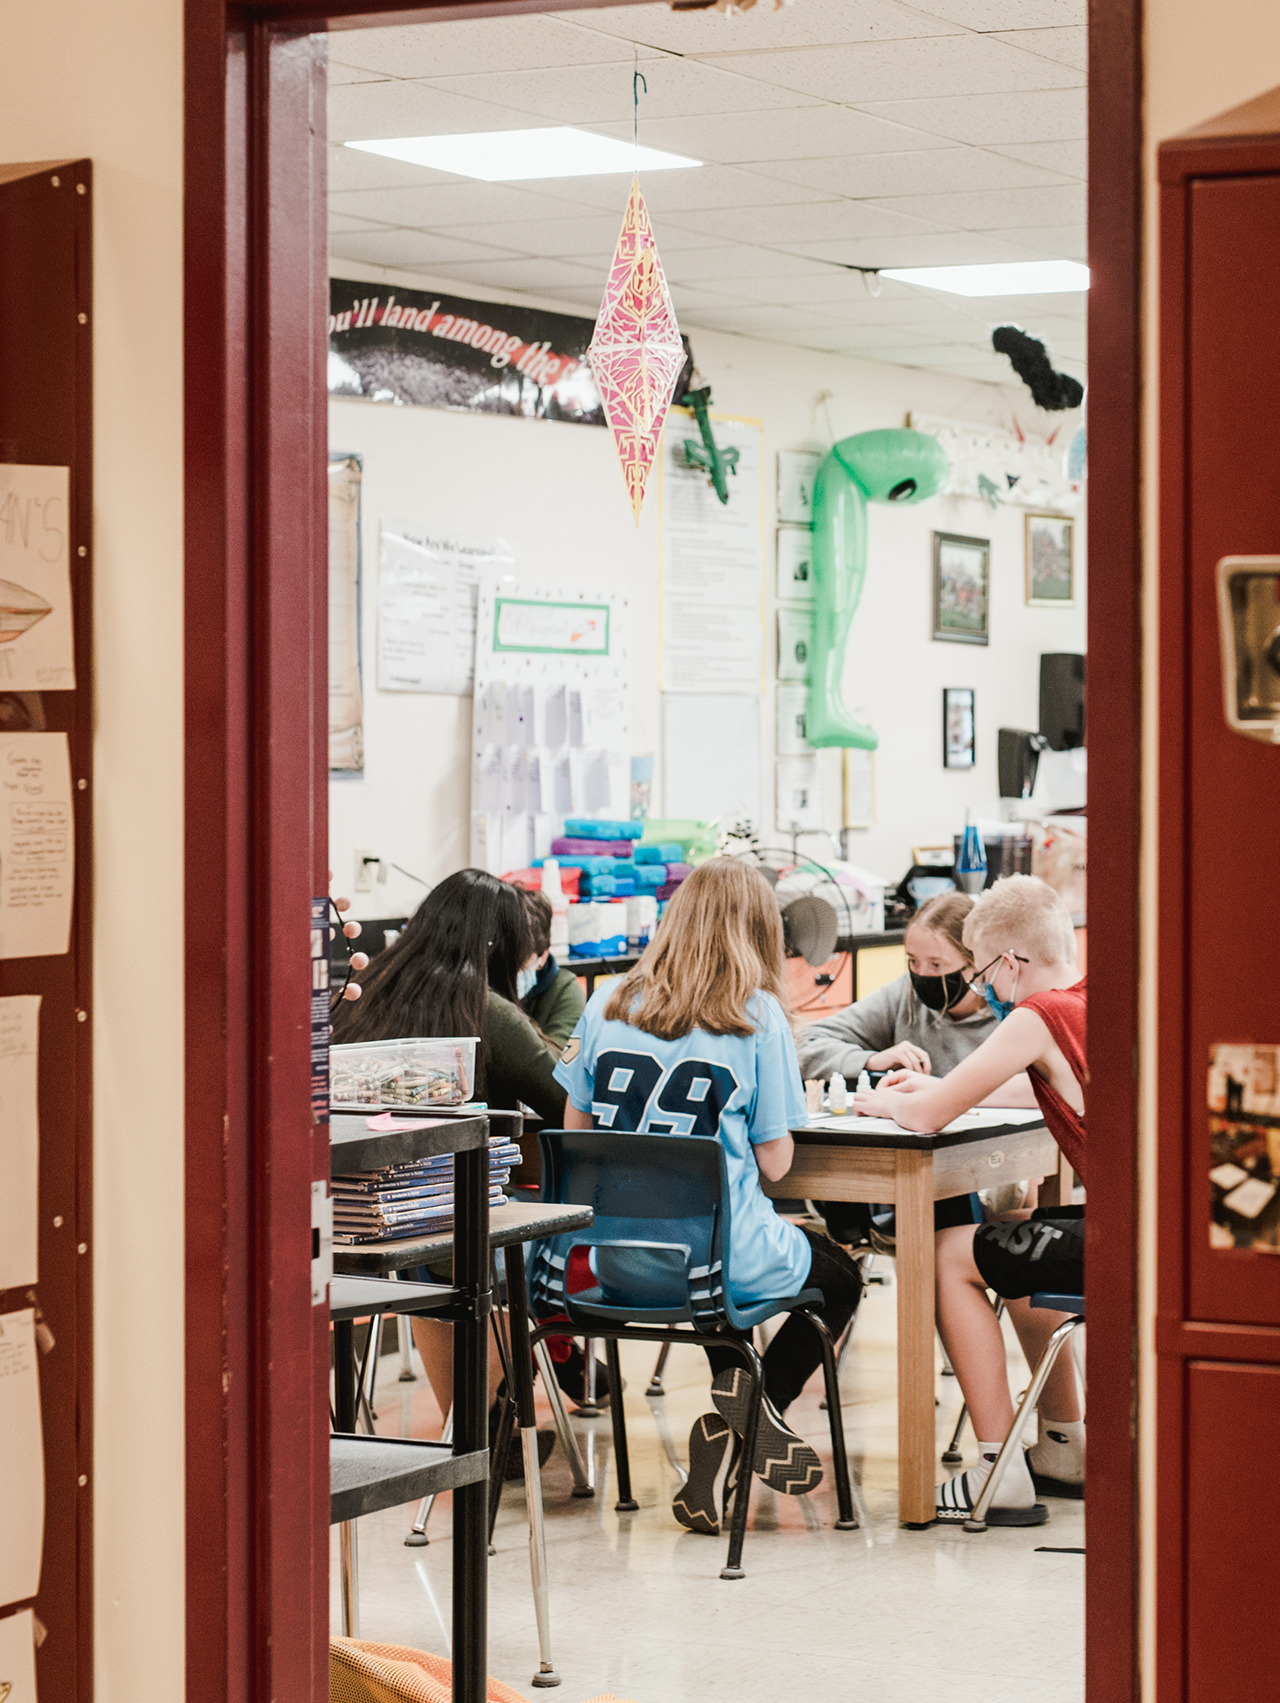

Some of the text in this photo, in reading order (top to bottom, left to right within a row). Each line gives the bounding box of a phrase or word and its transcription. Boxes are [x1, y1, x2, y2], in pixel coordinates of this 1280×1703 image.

[379, 295, 441, 332] land
[432, 314, 524, 368] among
[516, 341, 560, 387] the
[592, 1047, 741, 1137] 99
[937, 1509, 972, 1519] adidas
